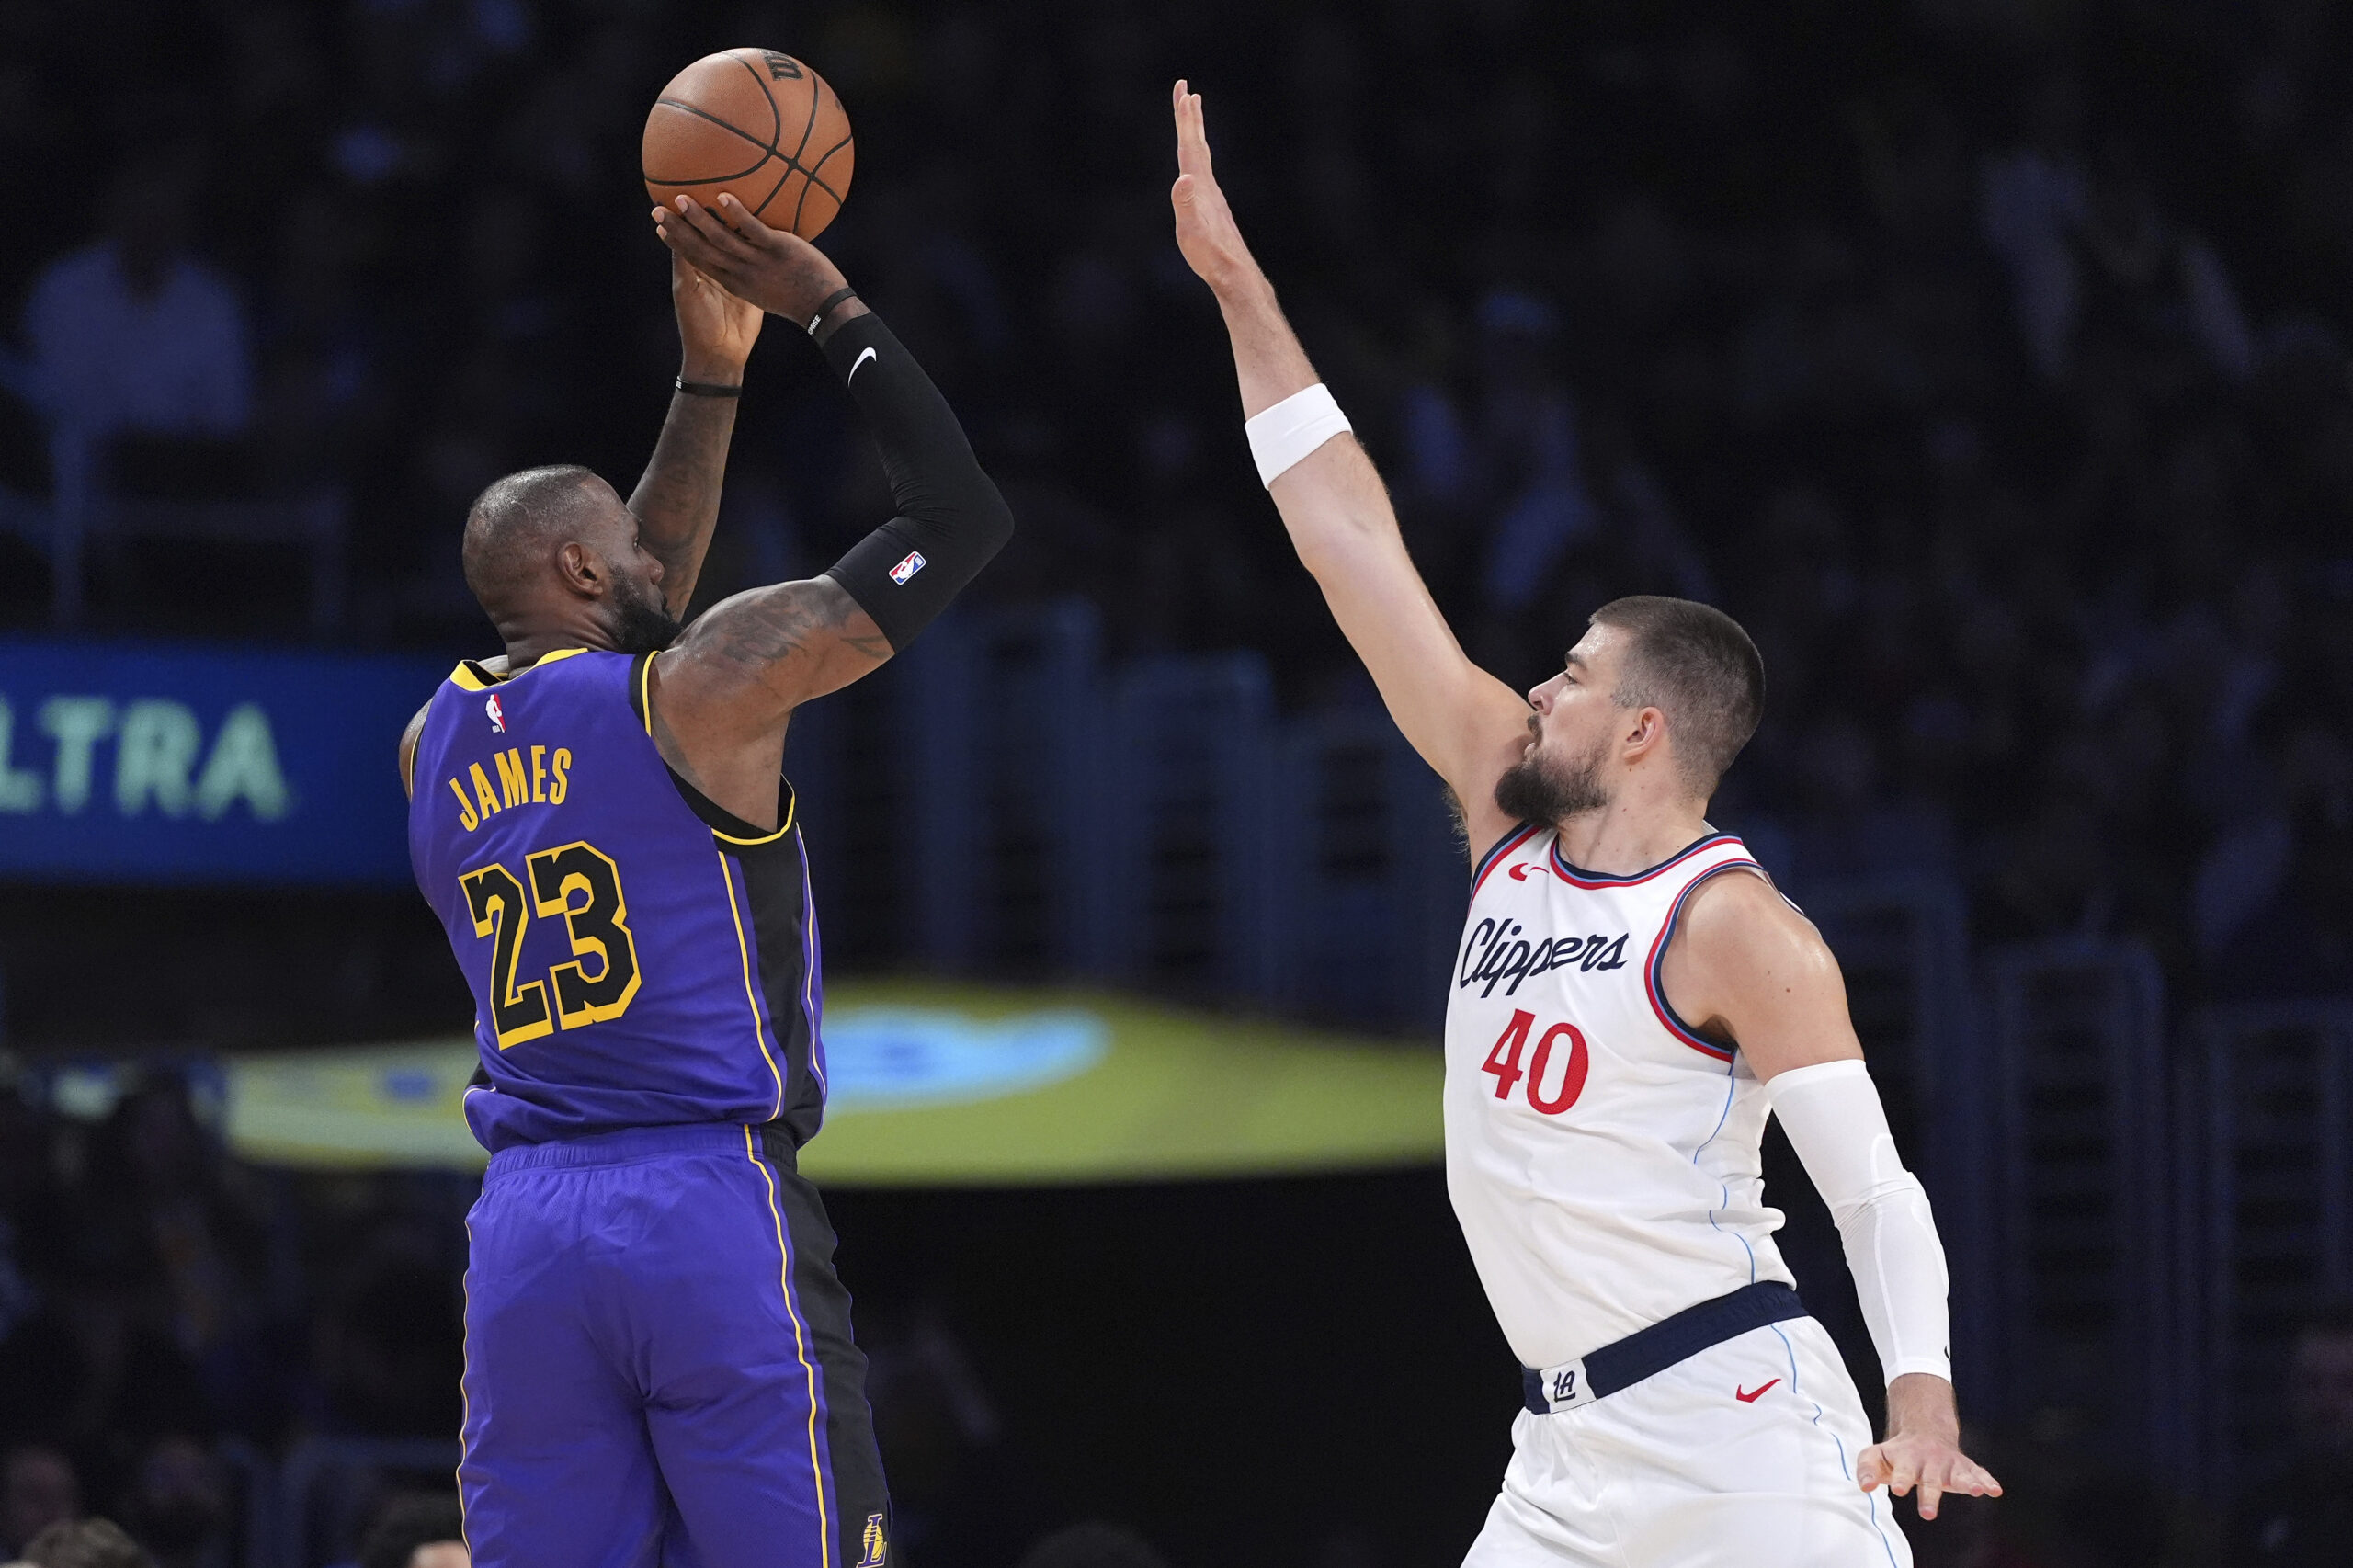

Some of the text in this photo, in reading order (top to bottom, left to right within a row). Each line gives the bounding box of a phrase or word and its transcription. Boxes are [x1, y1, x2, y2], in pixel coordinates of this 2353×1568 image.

[449, 744, 572, 832] JAMES
[458, 840, 642, 1051] 23
[1460, 917, 1630, 999] Clippers
[1481, 1008, 1589, 1115] 40
